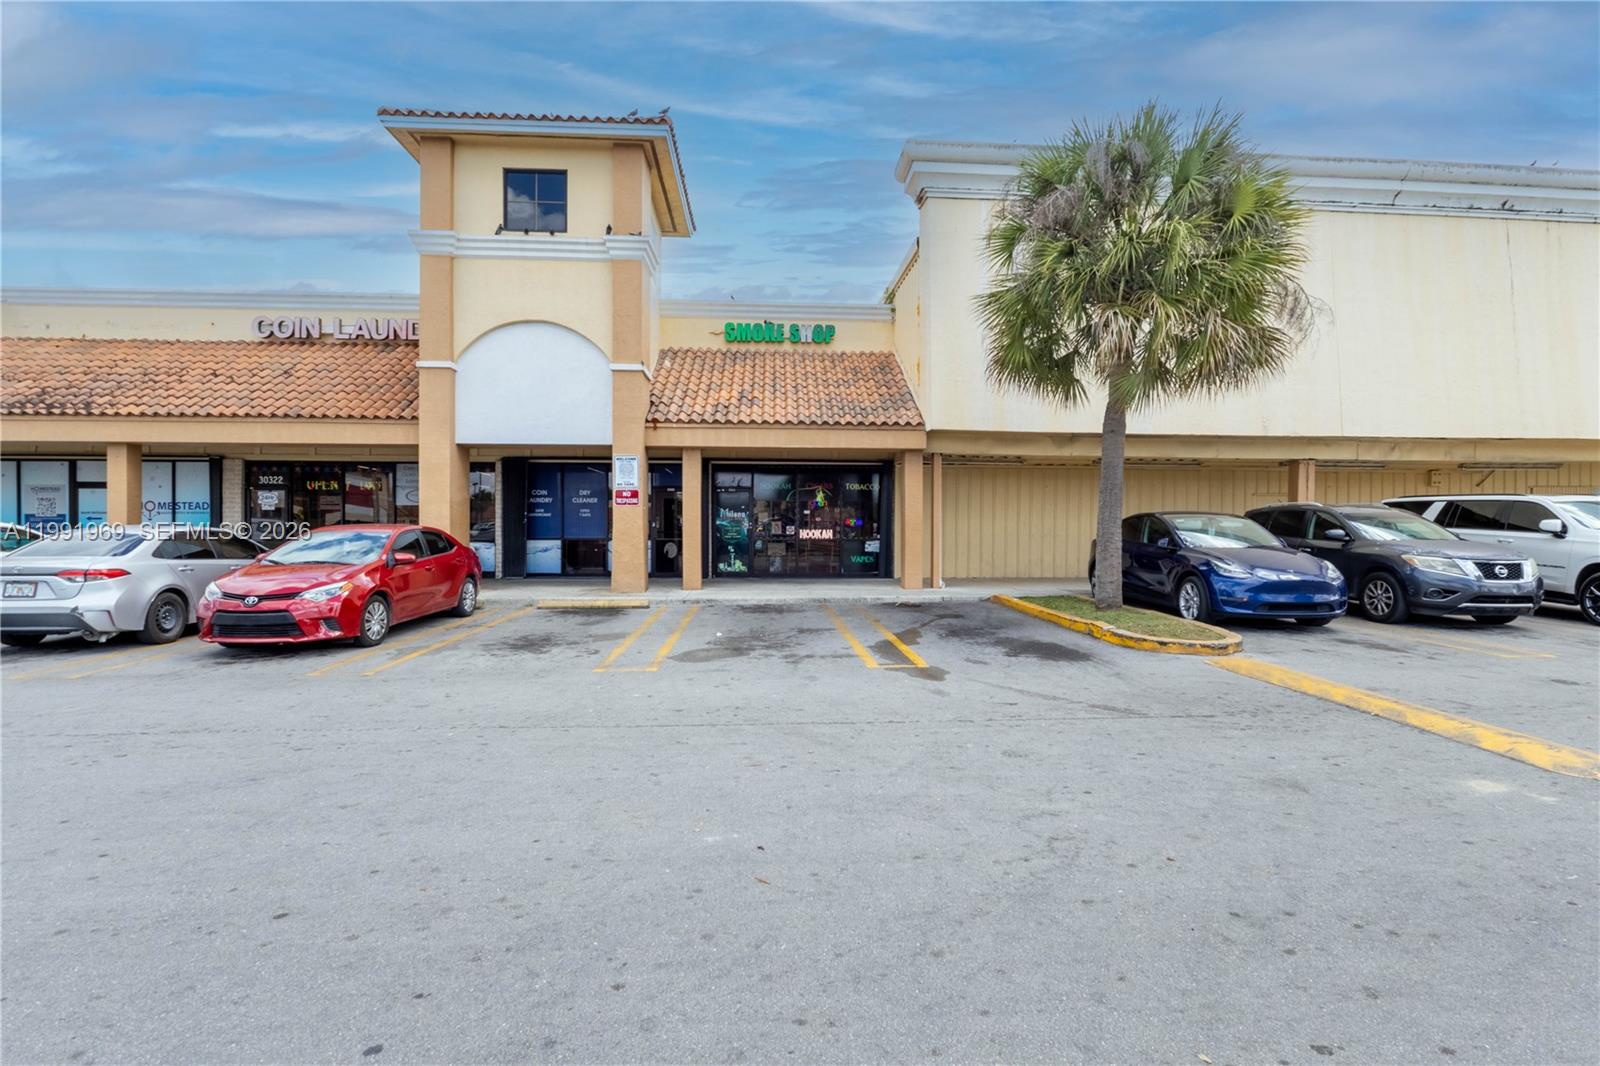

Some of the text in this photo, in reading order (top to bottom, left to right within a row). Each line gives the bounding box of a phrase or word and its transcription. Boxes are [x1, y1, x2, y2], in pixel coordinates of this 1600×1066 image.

[252, 316, 322, 339] COIN
[724, 322, 836, 344] SMOKE SHOP
[258, 475, 284, 485] 30322
[306, 480, 338, 490] OPEN
[141, 500, 210, 512] OMESTEAD
[799, 529, 833, 539] HOOKAH
